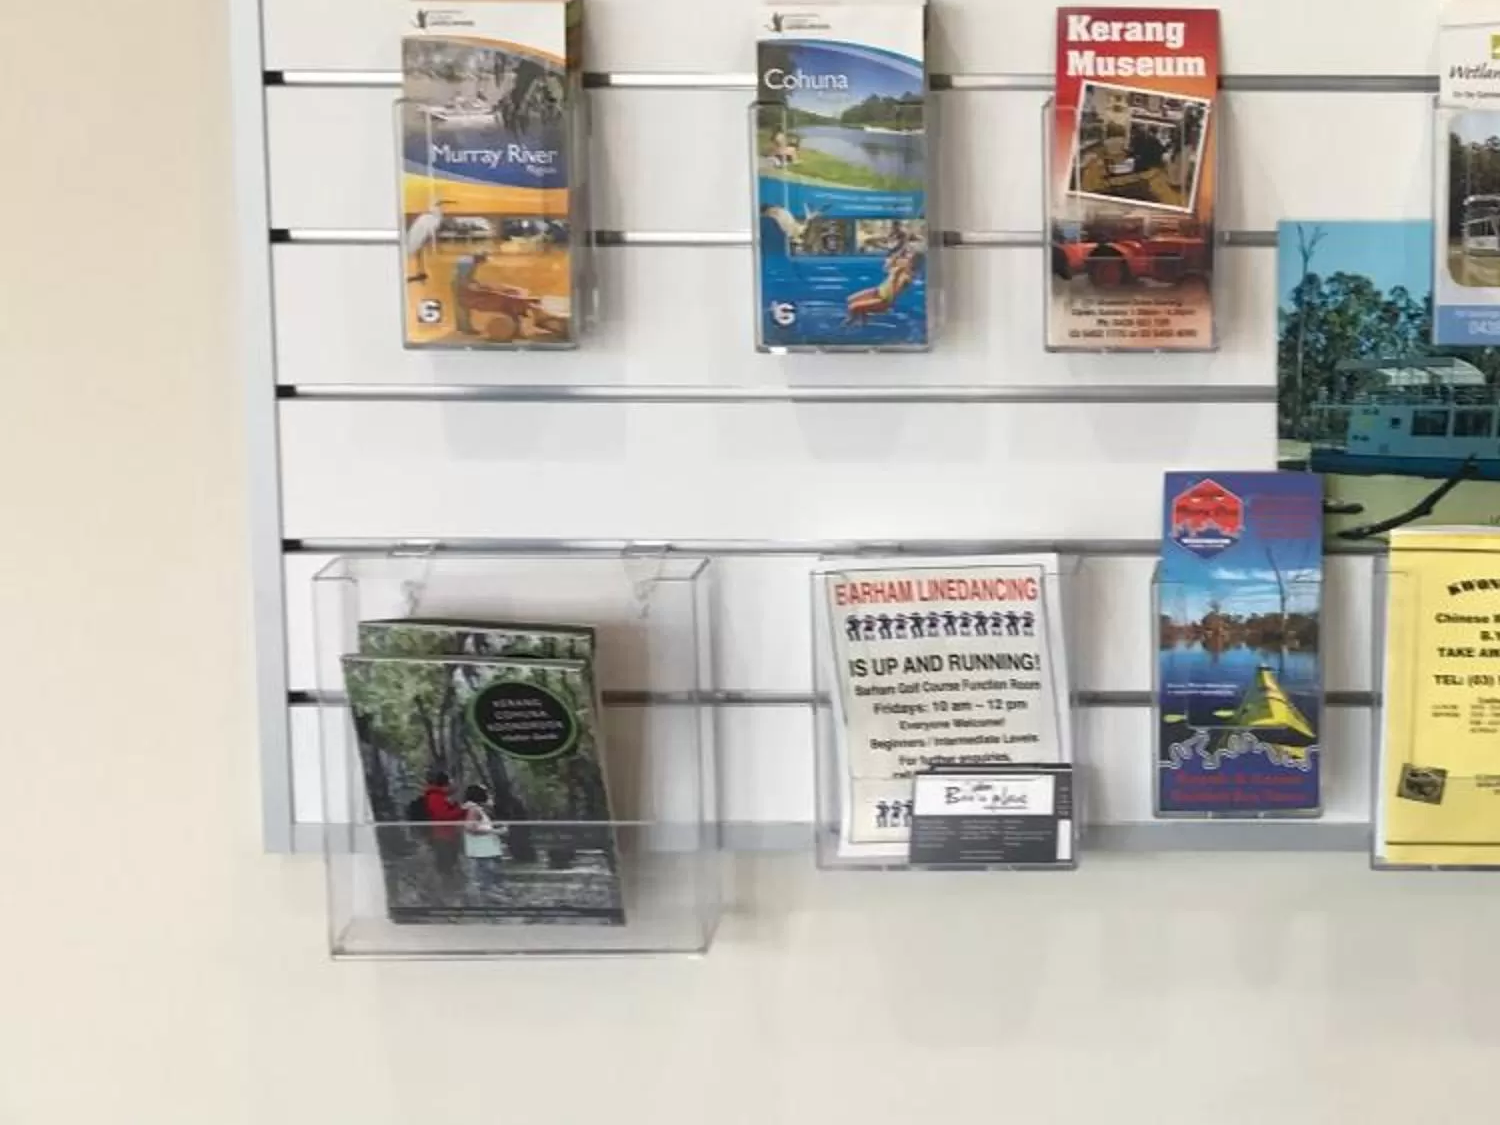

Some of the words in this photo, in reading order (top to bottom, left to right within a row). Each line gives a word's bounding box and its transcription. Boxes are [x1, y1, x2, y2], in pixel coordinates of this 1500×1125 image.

[1067, 14, 1185, 50] Kerang
[1067, 50, 1206, 77] Museum
[764, 68, 849, 91] Cohuna
[430, 143, 501, 168] Murray
[507, 143, 558, 164] River
[918, 578, 1037, 602] LINEDANCING
[1434, 612, 1490, 624] Chinese
[1437, 647, 1476, 658] TAKE
[849, 658, 869, 677] IS
[873, 657, 898, 676] UP
[902, 655, 943, 673] AND
[949, 653, 1041, 672] RUNNING!
[1434, 674, 1465, 686] TEL:
[931, 701, 948, 712] 10
